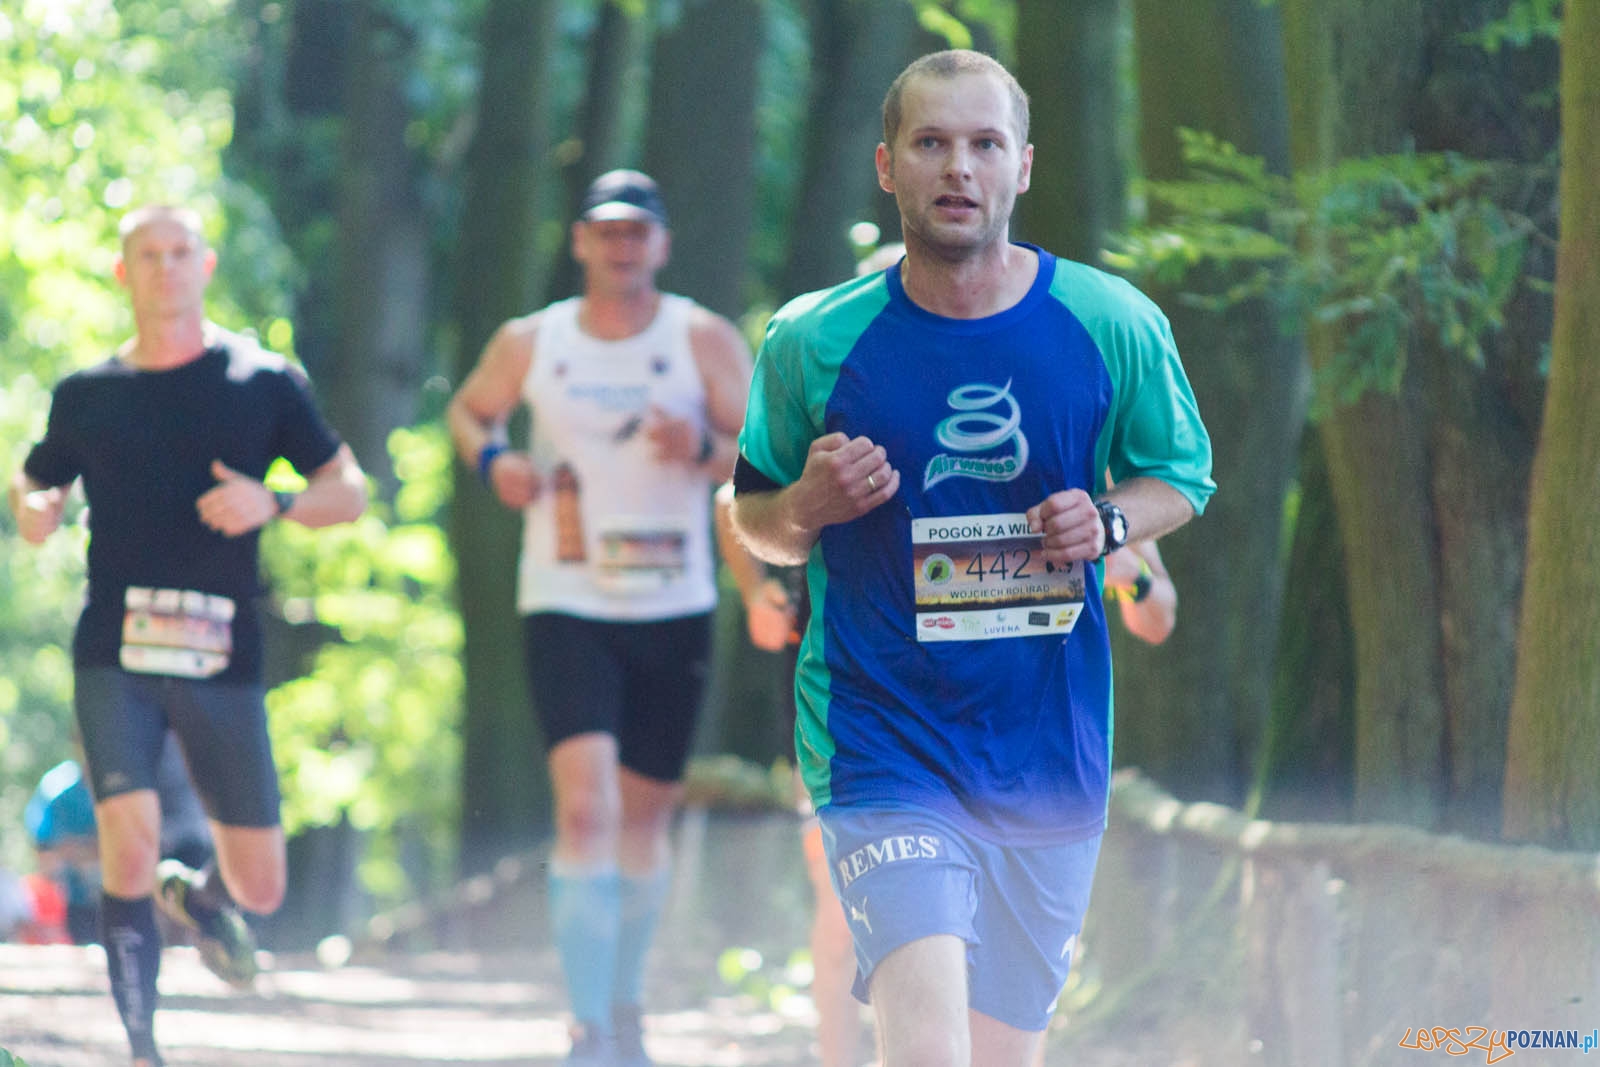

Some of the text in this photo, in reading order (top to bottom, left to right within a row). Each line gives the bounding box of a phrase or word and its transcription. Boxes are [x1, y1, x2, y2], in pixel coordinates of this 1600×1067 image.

[928, 523, 982, 540] POGOŃ
[986, 525, 1006, 537] ZA
[966, 548, 1031, 582] 442
[950, 588, 1003, 599] WOJCIECH
[984, 625, 1021, 635] LUVENA
[838, 835, 937, 888] REMES
